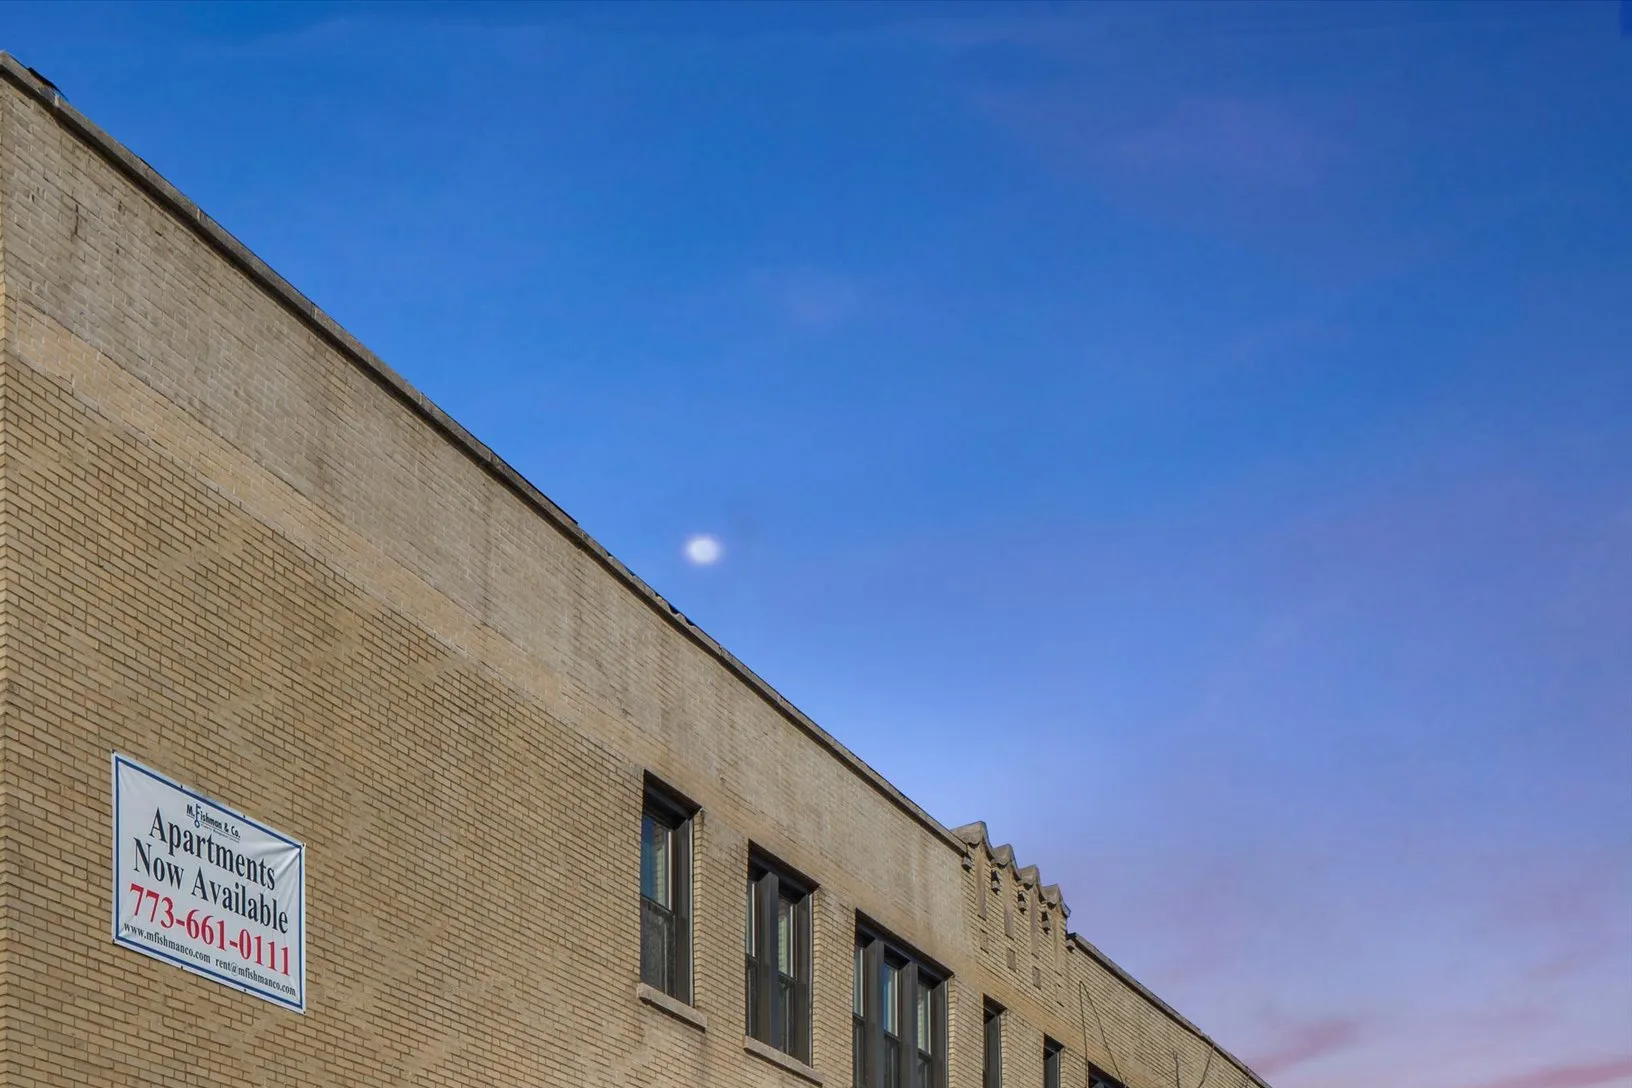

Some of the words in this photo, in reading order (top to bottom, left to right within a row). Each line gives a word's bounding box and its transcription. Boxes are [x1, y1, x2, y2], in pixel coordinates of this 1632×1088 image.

[133, 837, 184, 890] Now
[191, 866, 288, 934] Available
[149, 806, 275, 891] Apartments
[123, 922, 211, 964] www.mfishmanco.com
[215, 958, 296, 996] rent@mfishmanco.com
[130, 883, 290, 976] 773-661-0111
